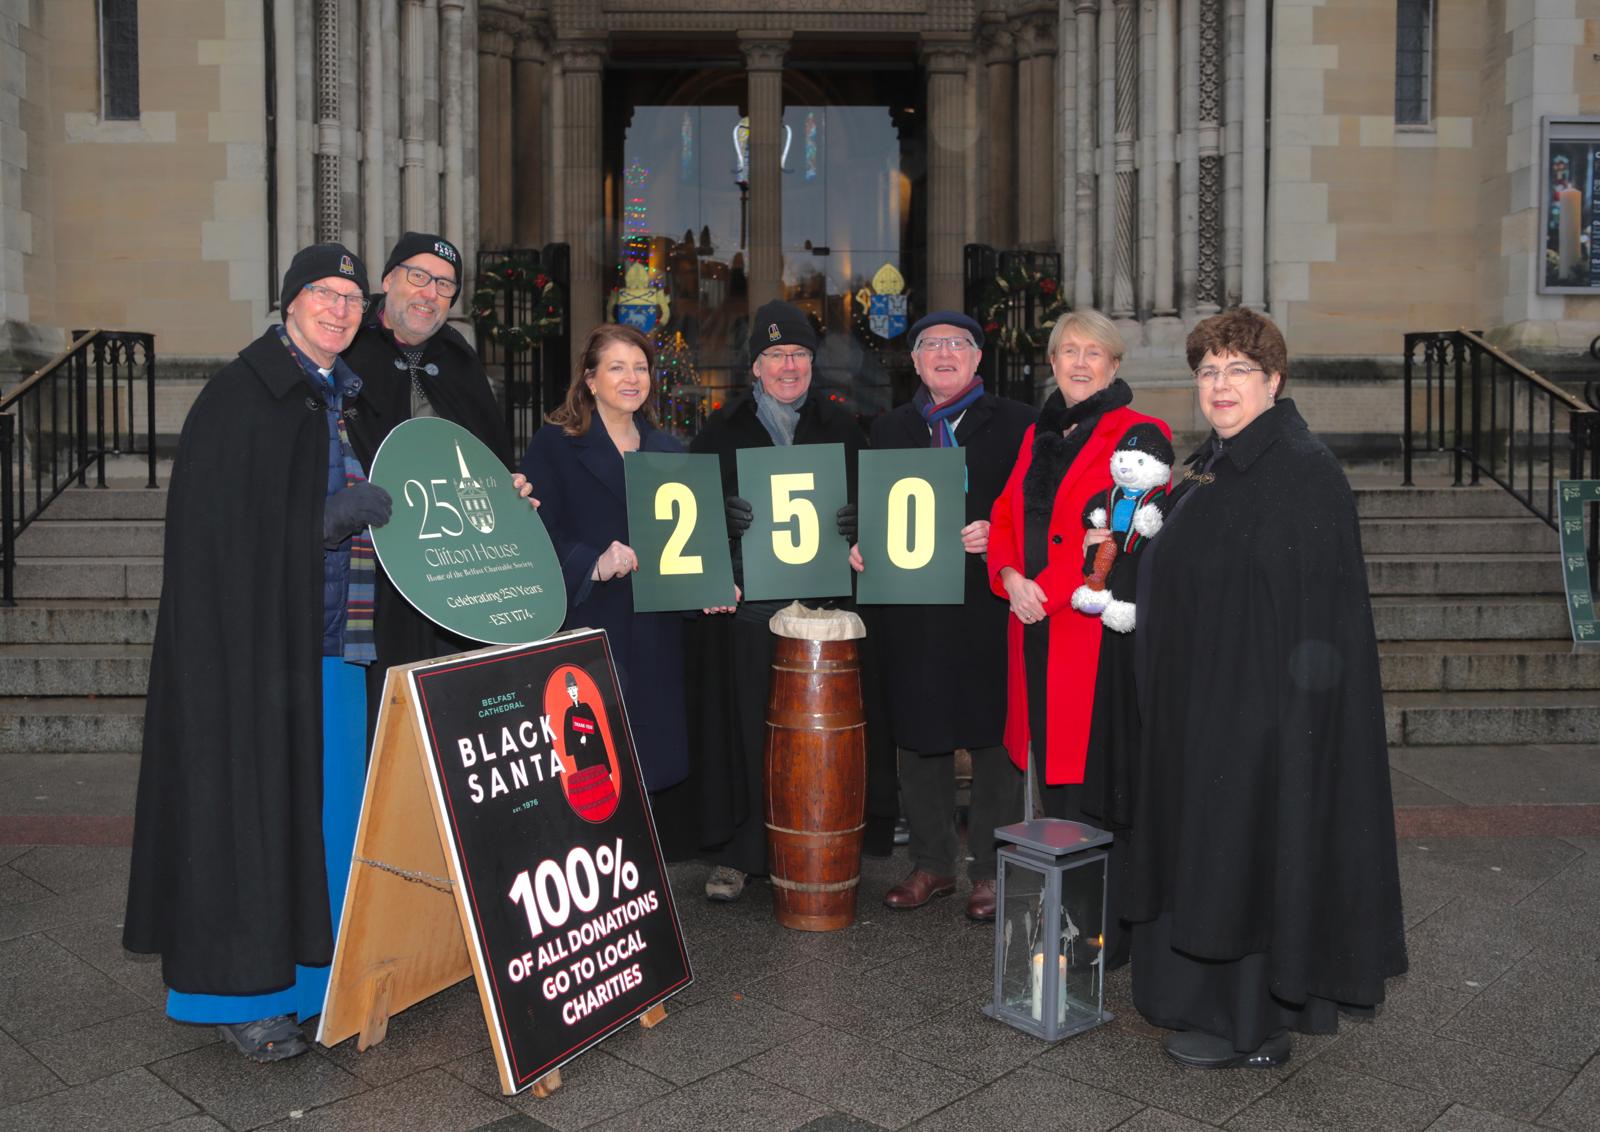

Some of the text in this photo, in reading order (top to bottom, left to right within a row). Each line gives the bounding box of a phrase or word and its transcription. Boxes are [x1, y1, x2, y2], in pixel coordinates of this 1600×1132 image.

[654, 472, 936, 576] 2 5 0
[424, 543, 520, 567] Clifton House
[426, 561, 534, 582] Home of the Belfast Charitable Society
[447, 584, 543, 609] Celebrating 250 Years
[478, 701, 526, 718] CATHEDRAL
[482, 692, 517, 707] BELFAST
[457, 714, 557, 768] BLACK
[467, 749, 567, 804] SANTA
[522, 798, 539, 809] 1976
[508, 837, 640, 939] 100%
[508, 889, 659, 983] OF ALL DONATIONS
[542, 930, 647, 1000] GO TO LOCAL
[561, 963, 644, 1026] CHARITIES
